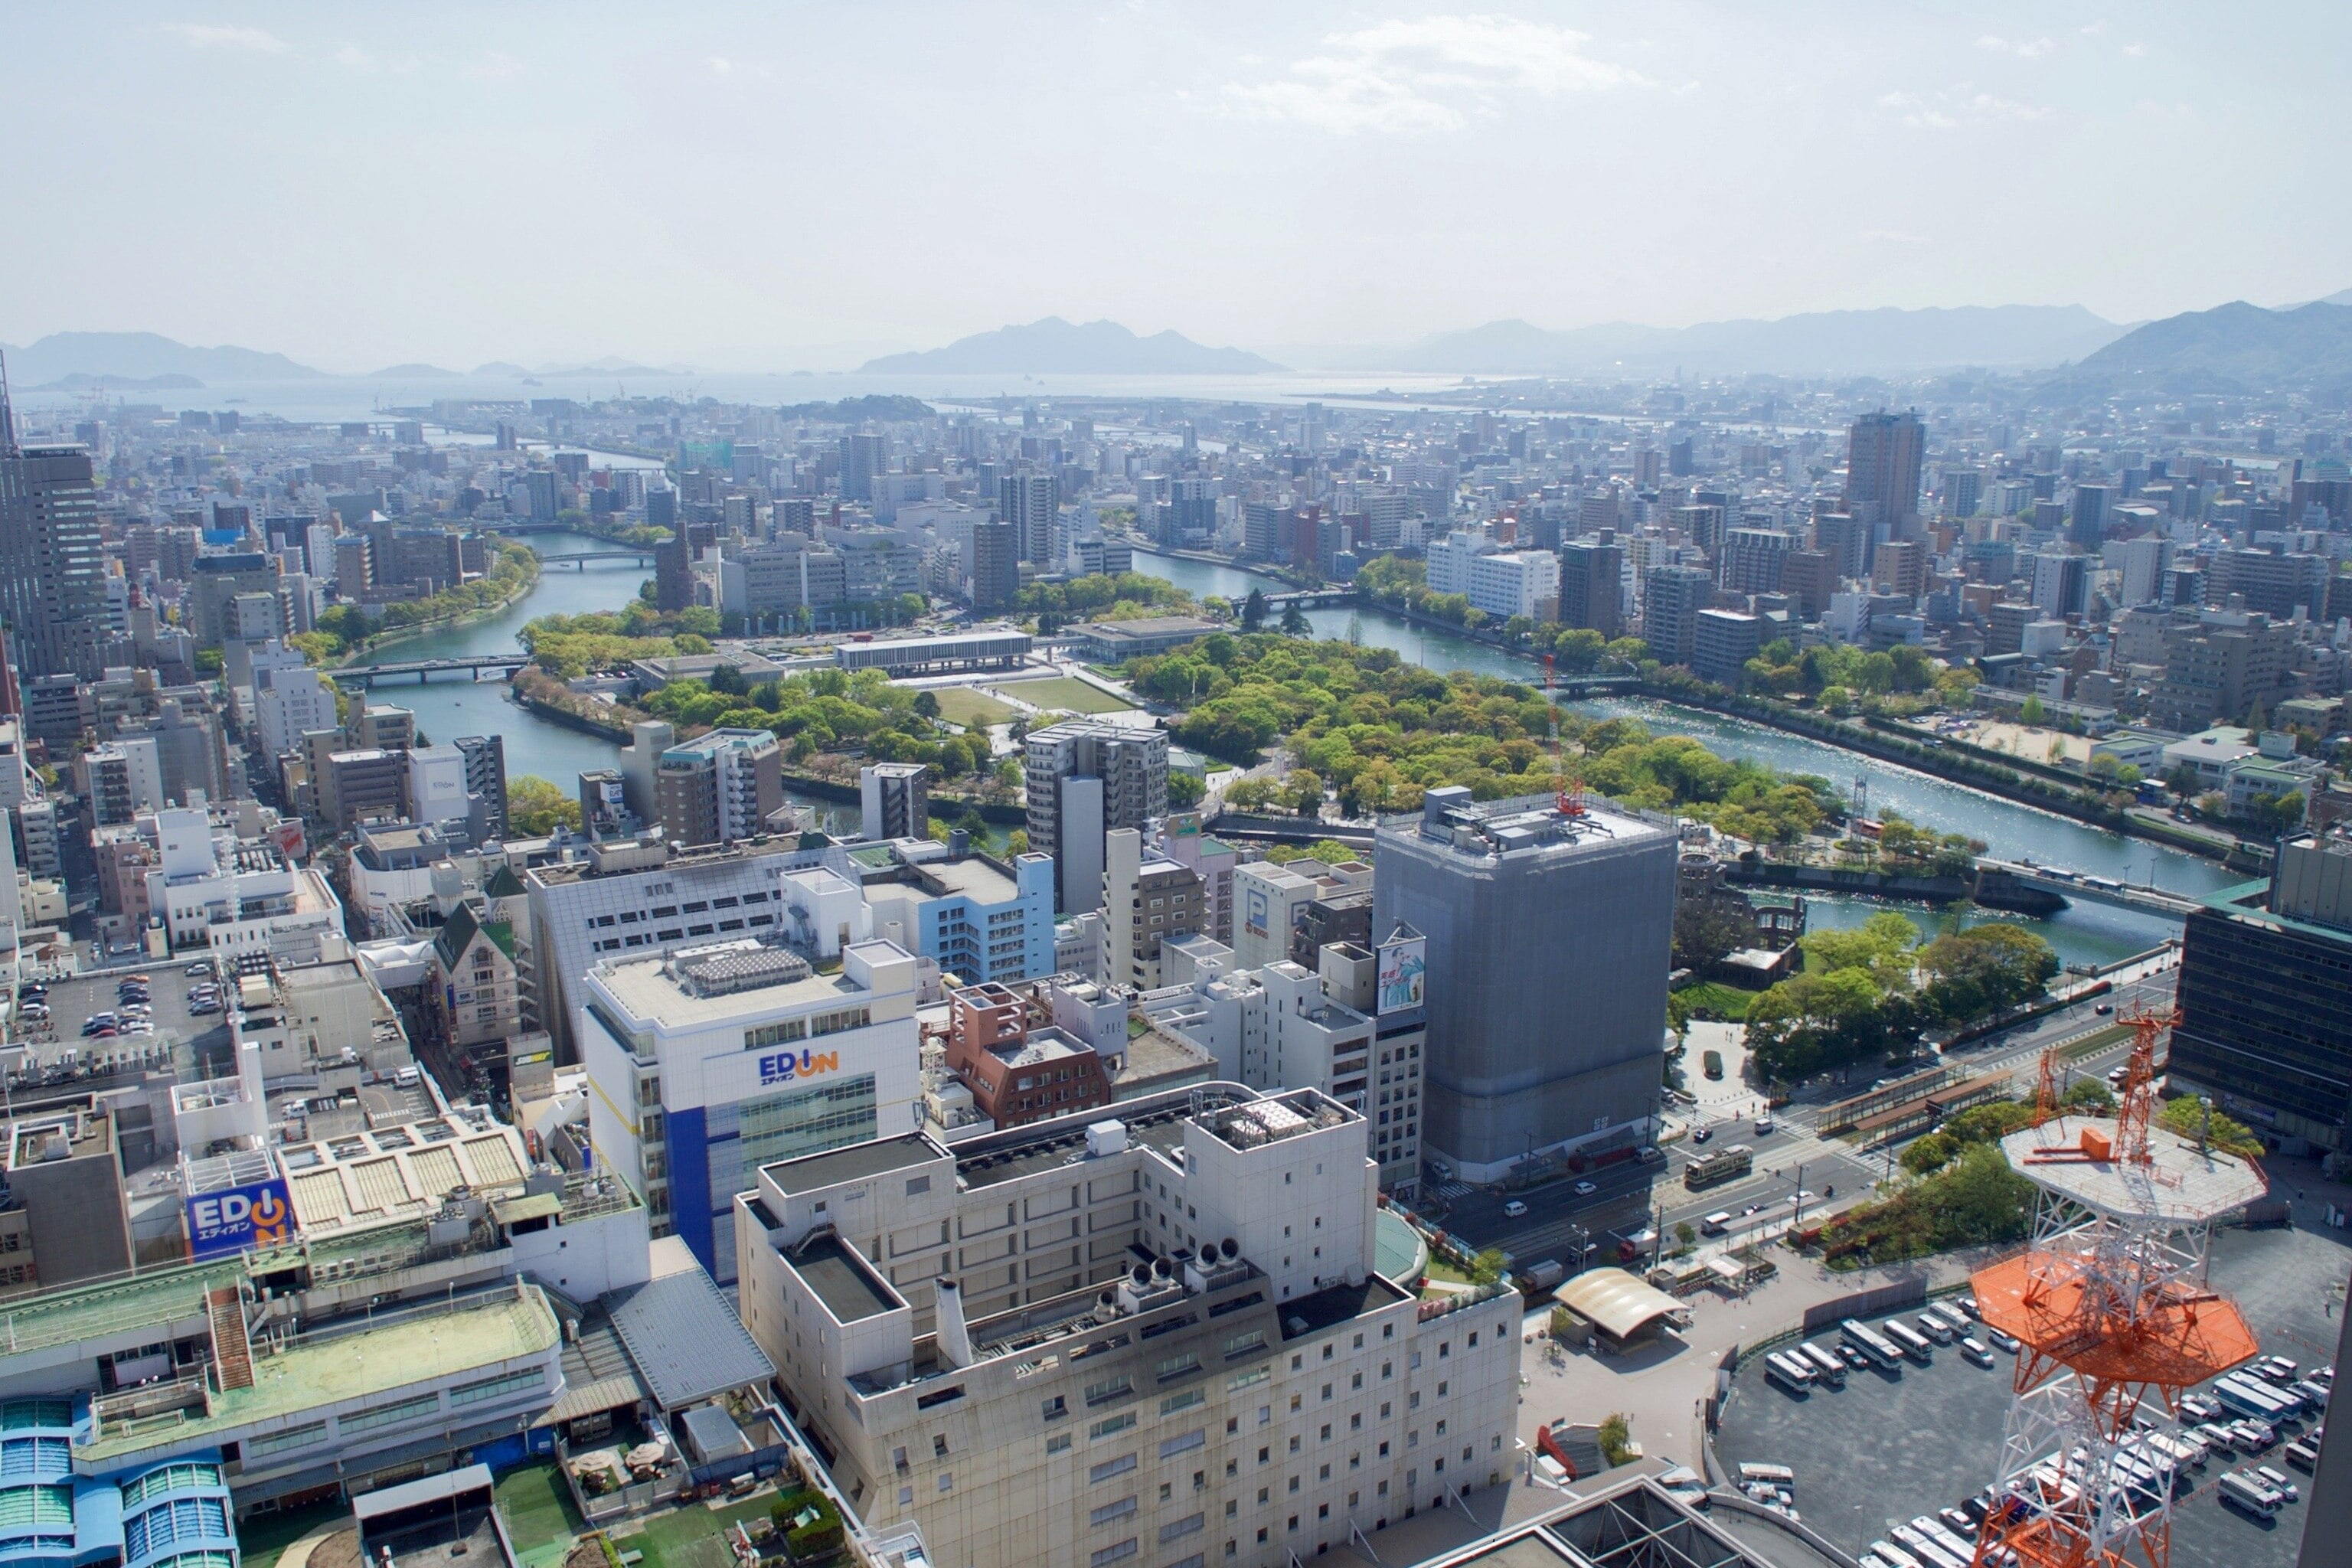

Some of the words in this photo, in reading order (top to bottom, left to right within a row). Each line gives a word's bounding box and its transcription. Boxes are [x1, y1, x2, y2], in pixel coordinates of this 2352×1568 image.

[1250, 891, 1266, 923] P
[1293, 903, 1309, 924] P
[515, 1051, 550, 1066] SUBWAY
[760, 1049, 839, 1078] EDION
[761, 1073, 795, 1086] エディオン
[198, 1222, 250, 1240] エディオン
